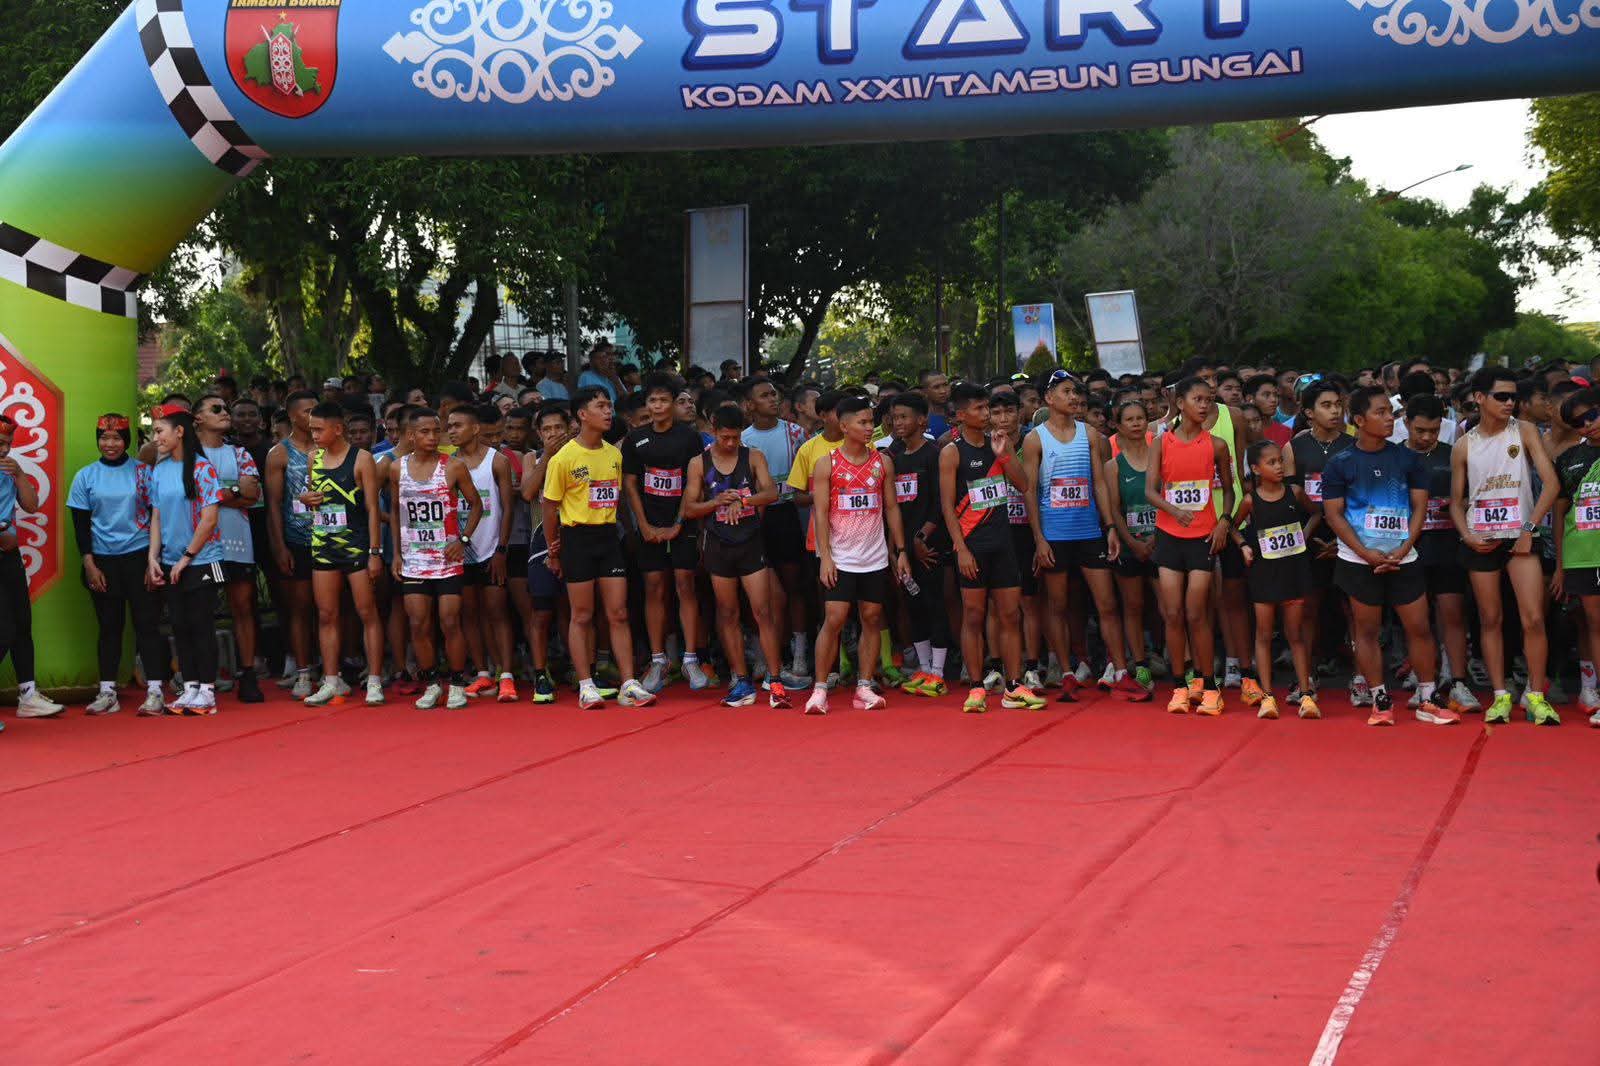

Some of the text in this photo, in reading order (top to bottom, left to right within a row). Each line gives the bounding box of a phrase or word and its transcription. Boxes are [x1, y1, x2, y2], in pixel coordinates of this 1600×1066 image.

[681, 49, 1302, 108] KODAM XXII/TAMBUN BUNGAI
[653, 477, 672, 489] 370
[597, 488, 614, 500] 236
[980, 485, 998, 501] 161
[1061, 486, 1082, 499] 482
[1175, 489, 1201, 504] 333
[849, 495, 869, 508] 164
[1137, 511, 1156, 525] 419
[1374, 515, 1401, 530] 1384
[1484, 508, 1508, 523] 642
[417, 530, 436, 542] 124
[1269, 533, 1295, 551] 328
